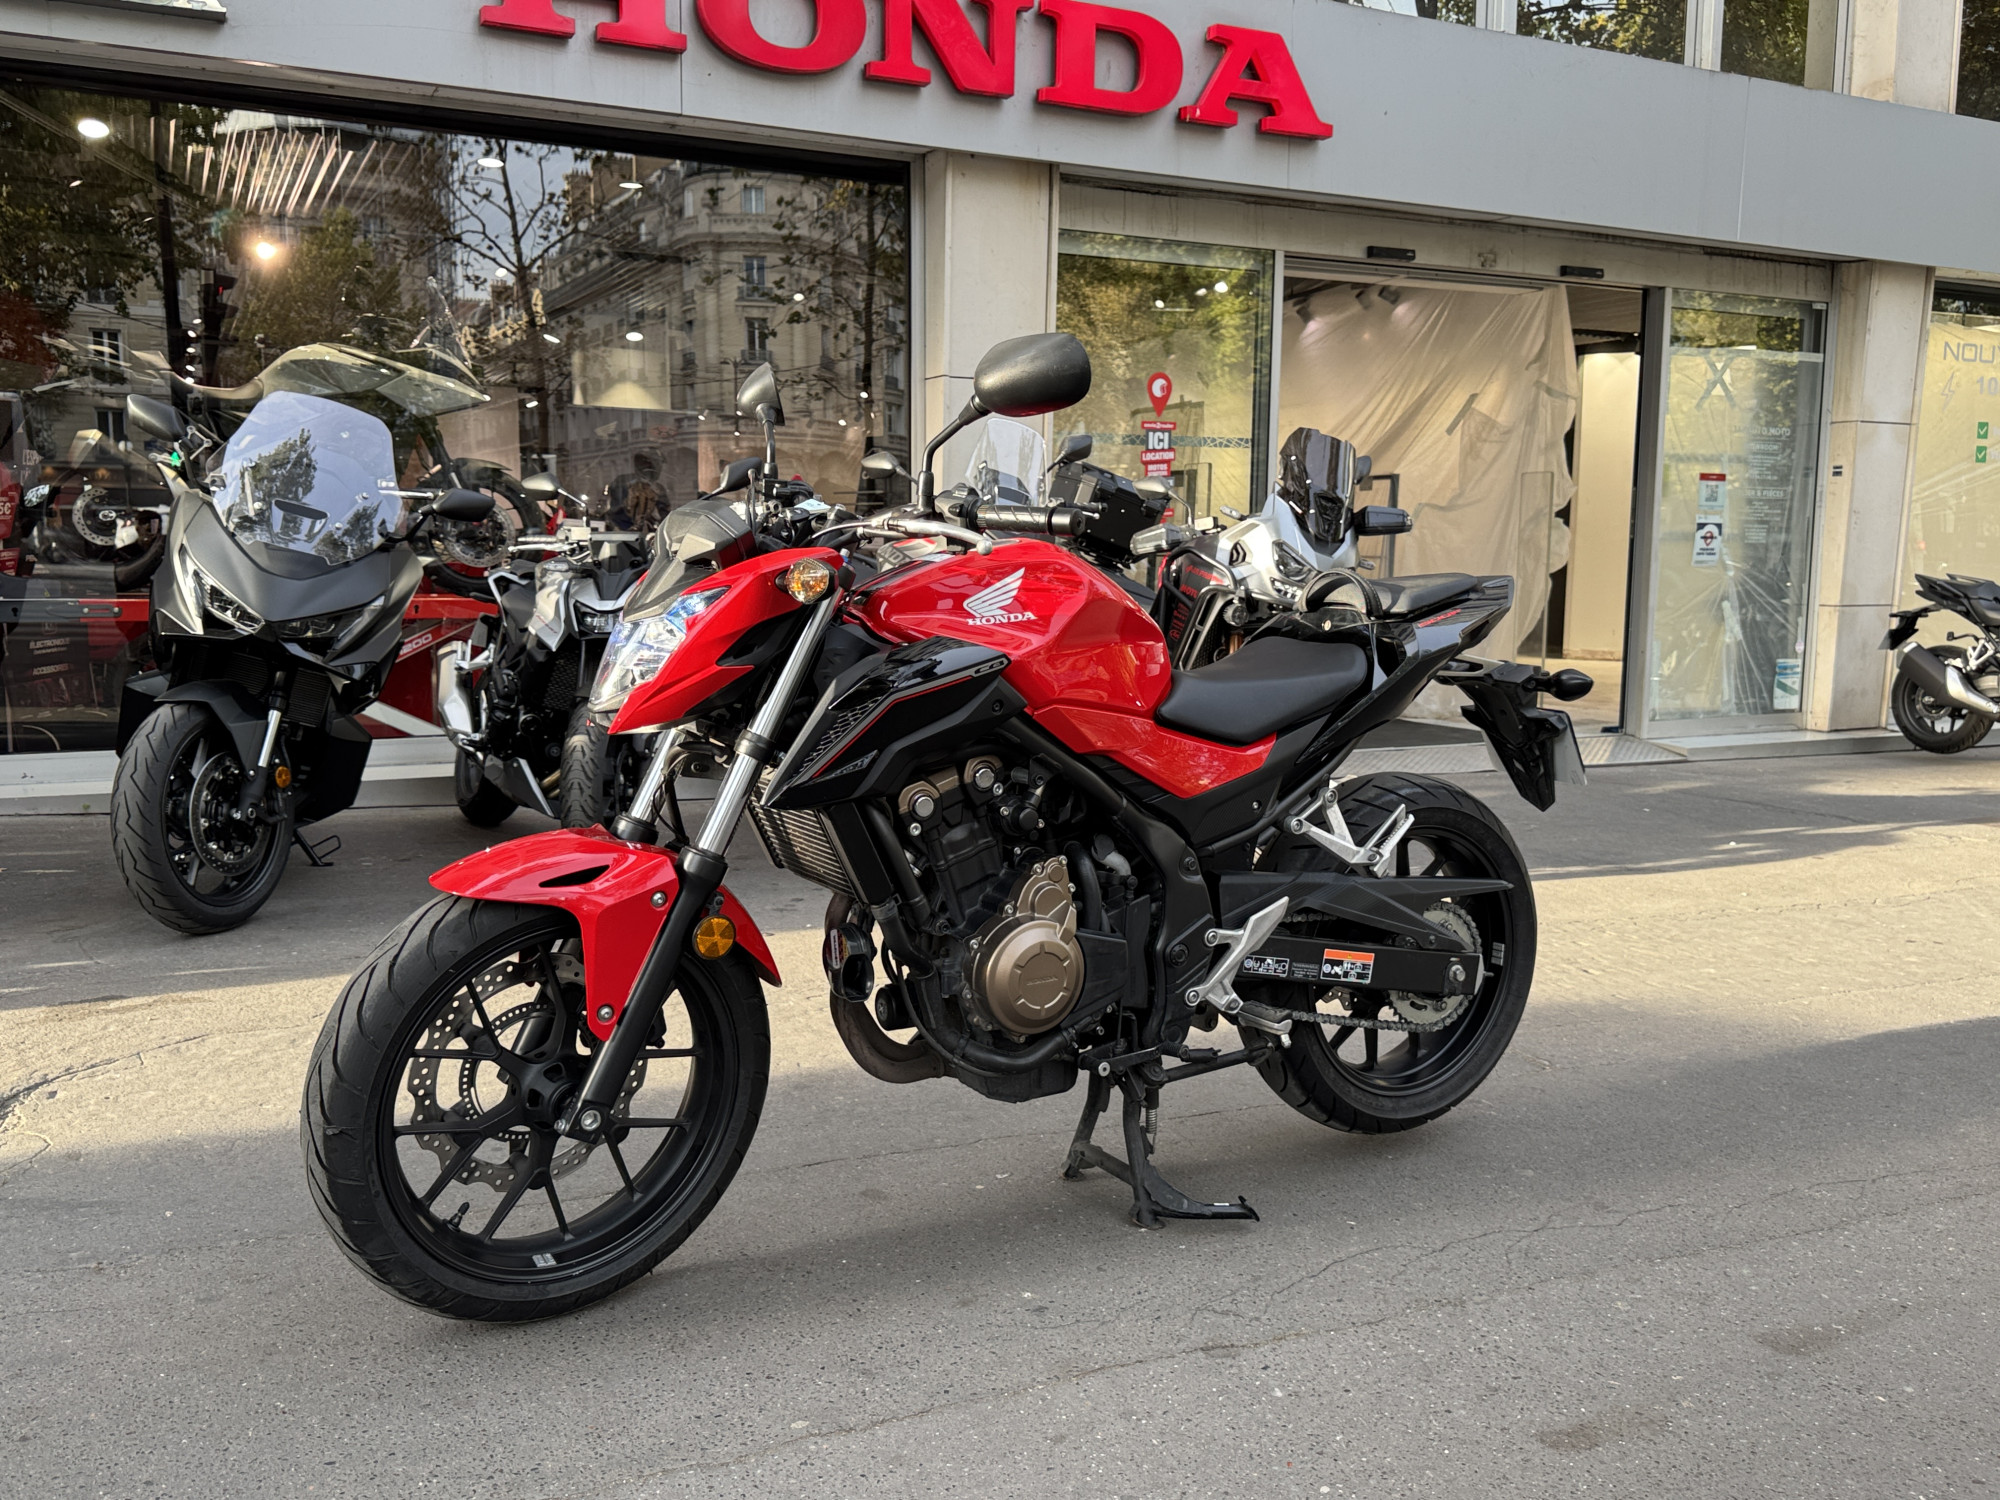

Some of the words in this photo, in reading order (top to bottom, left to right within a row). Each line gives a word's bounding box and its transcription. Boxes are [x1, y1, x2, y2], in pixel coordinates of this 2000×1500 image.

[1942, 341, 2000, 364] NOU
[1148, 431, 1169, 450] ICI
[1142, 451, 1175, 461] LOCATION
[966, 611, 1038, 626] HONDA
